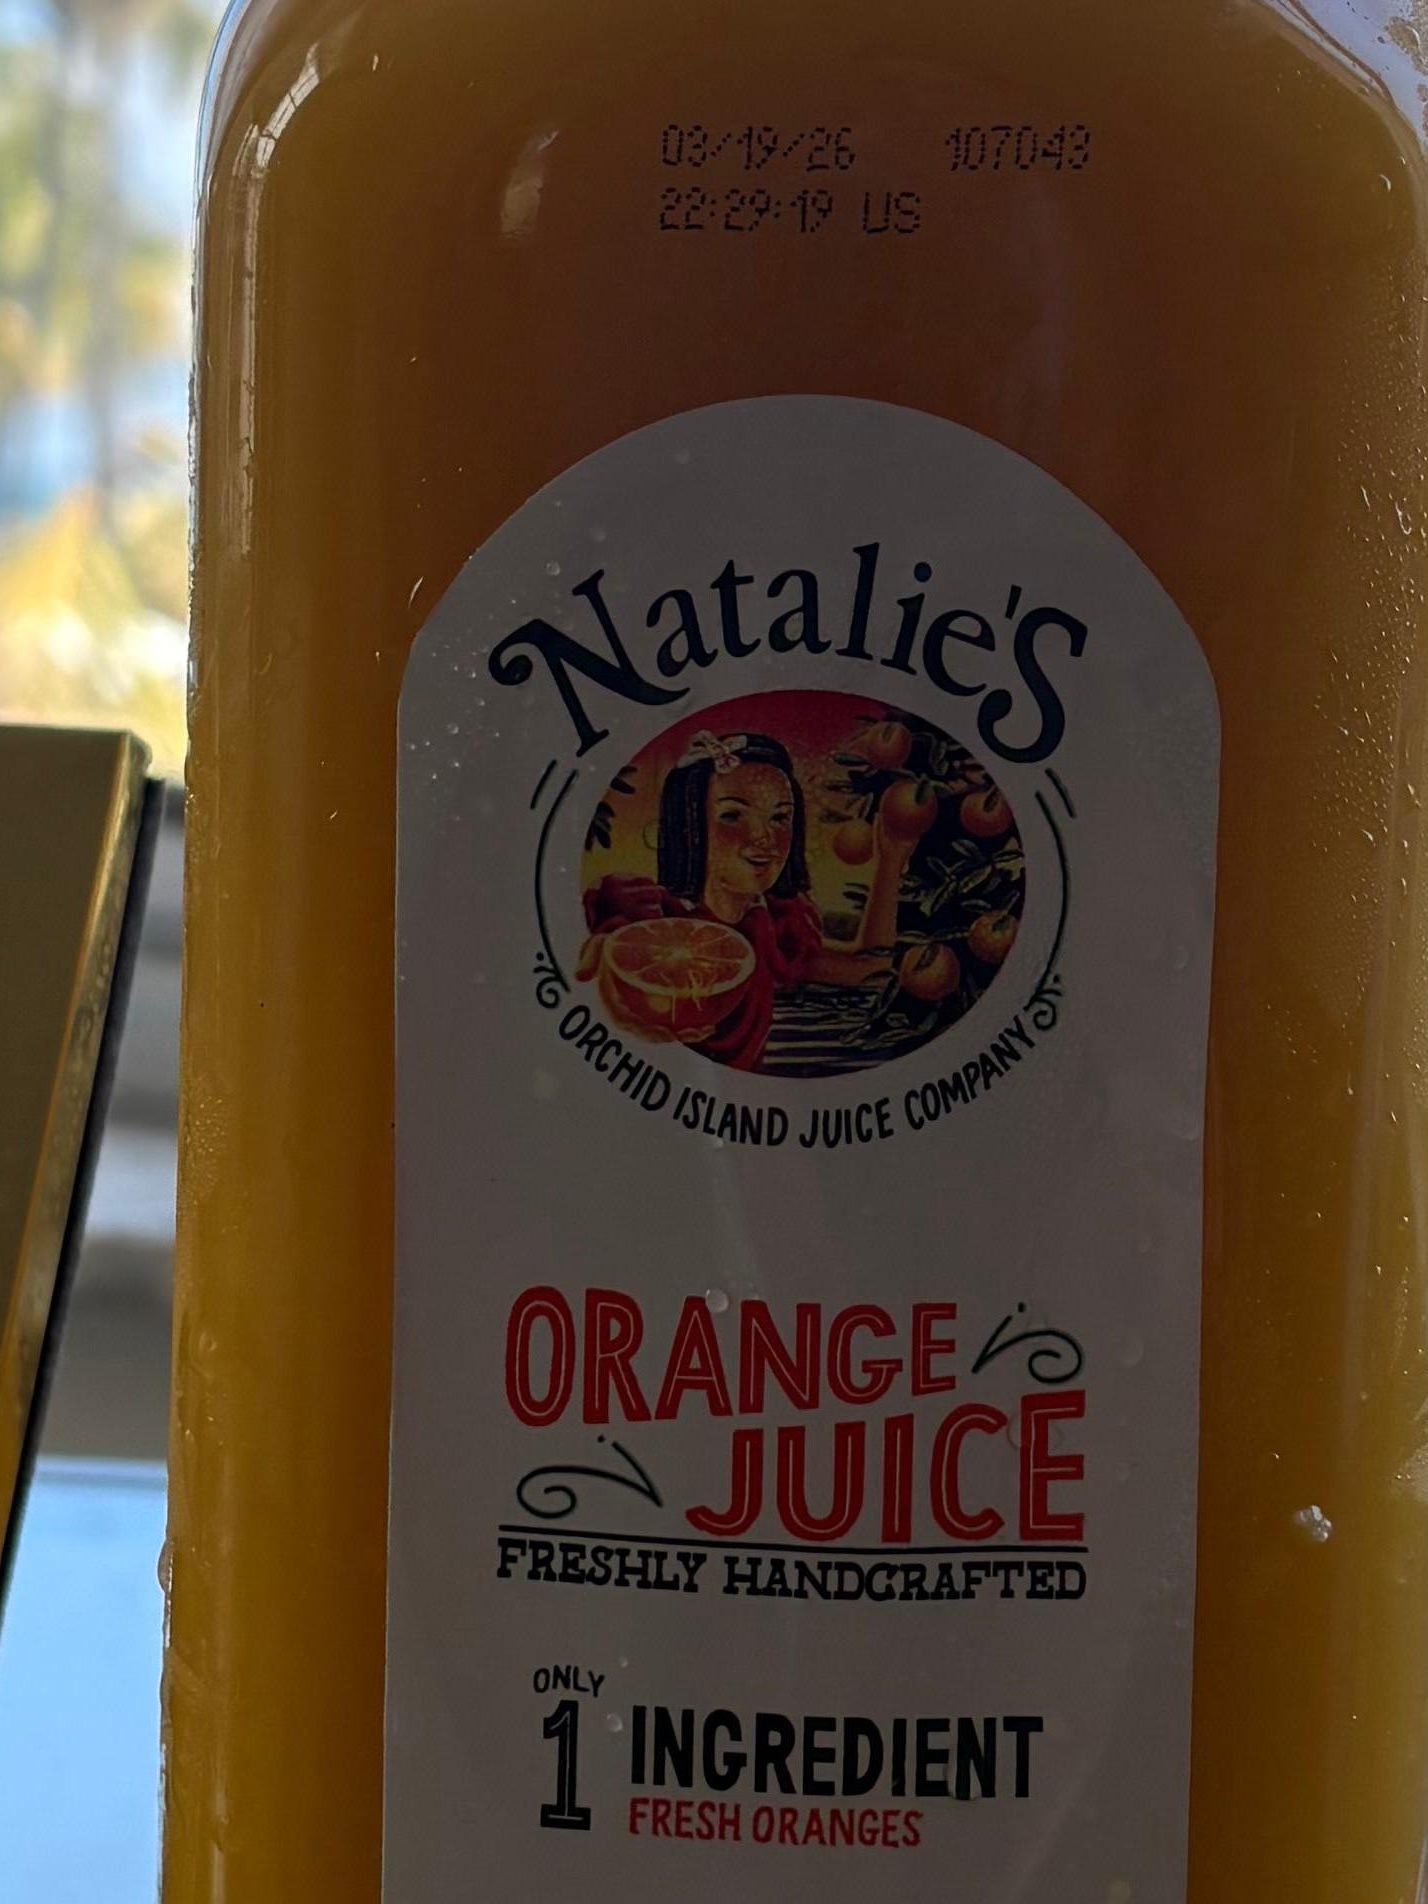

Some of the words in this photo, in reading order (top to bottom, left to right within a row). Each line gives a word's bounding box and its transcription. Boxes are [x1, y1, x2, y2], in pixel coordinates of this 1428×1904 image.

[944, 123, 1092, 173] 107043
[861, 190, 924, 236] US
[556, 1004, 674, 1112] ORCHID
[671, 1086, 788, 1148] ISLAND
[799, 1094, 894, 1149] JUICE
[904, 1013, 1039, 1131] COMPANY
[504, 1283, 958, 1428] ORANGE
[685, 1387, 1087, 1544] JUICE
[496, 1537, 709, 1593] FRESHLY
[722, 1555, 1088, 1601] HANDCRAFTED
[532, 1664, 605, 1698] ONLY
[539, 1699, 592, 1832] 1
[629, 1704, 1045, 1800] INGREDIENT
[627, 1797, 742, 1843] FRESH
[751, 1804, 925, 1849] ORANGES
